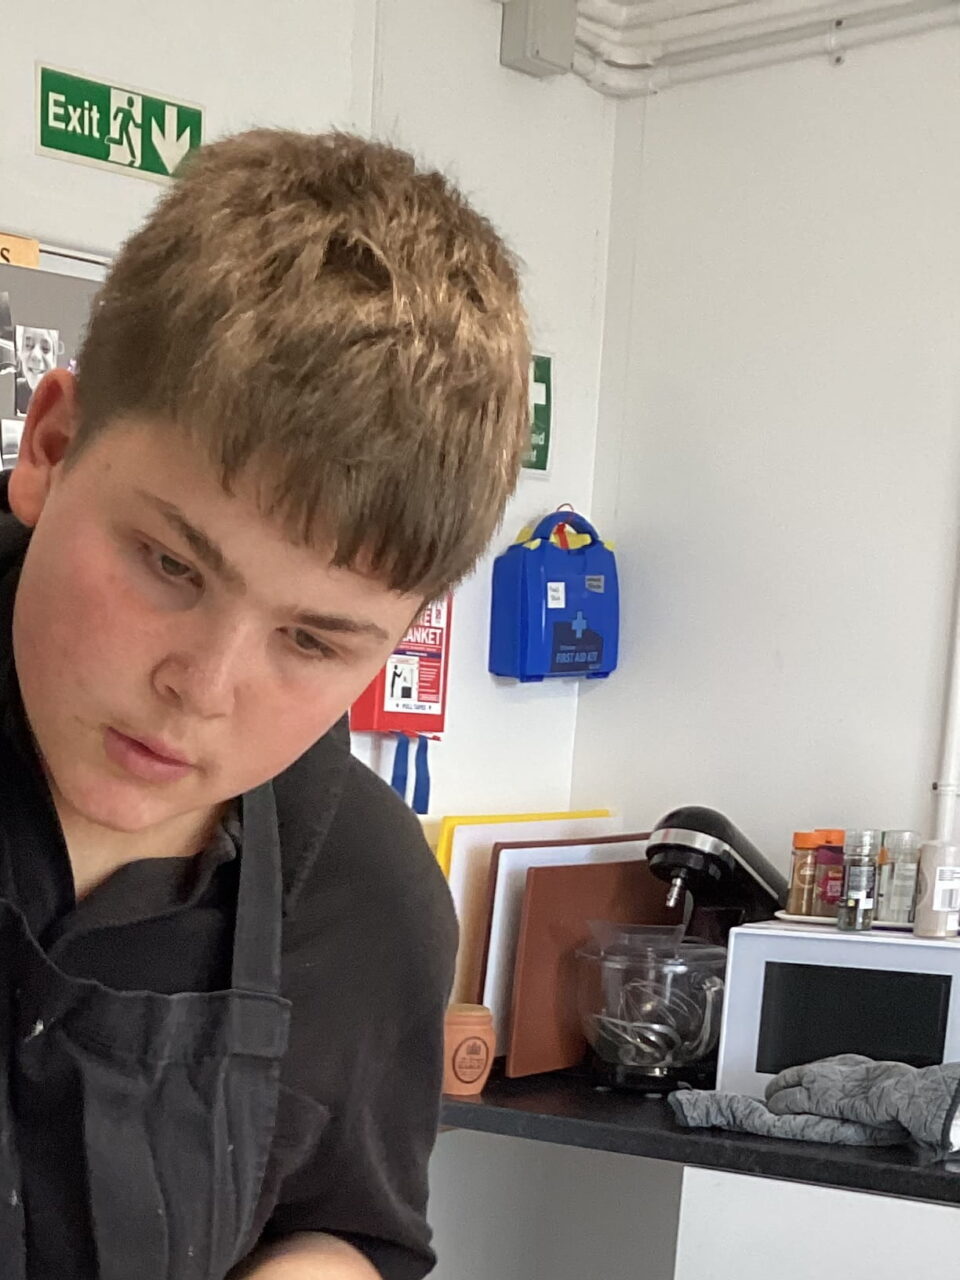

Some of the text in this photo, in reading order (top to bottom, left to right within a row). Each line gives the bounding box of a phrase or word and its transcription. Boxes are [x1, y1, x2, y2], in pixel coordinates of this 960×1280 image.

[48, 91, 100, 139] Exit
[402, 626, 442, 645] ANKET
[555, 651, 599, 663] FIRST AID KIT
